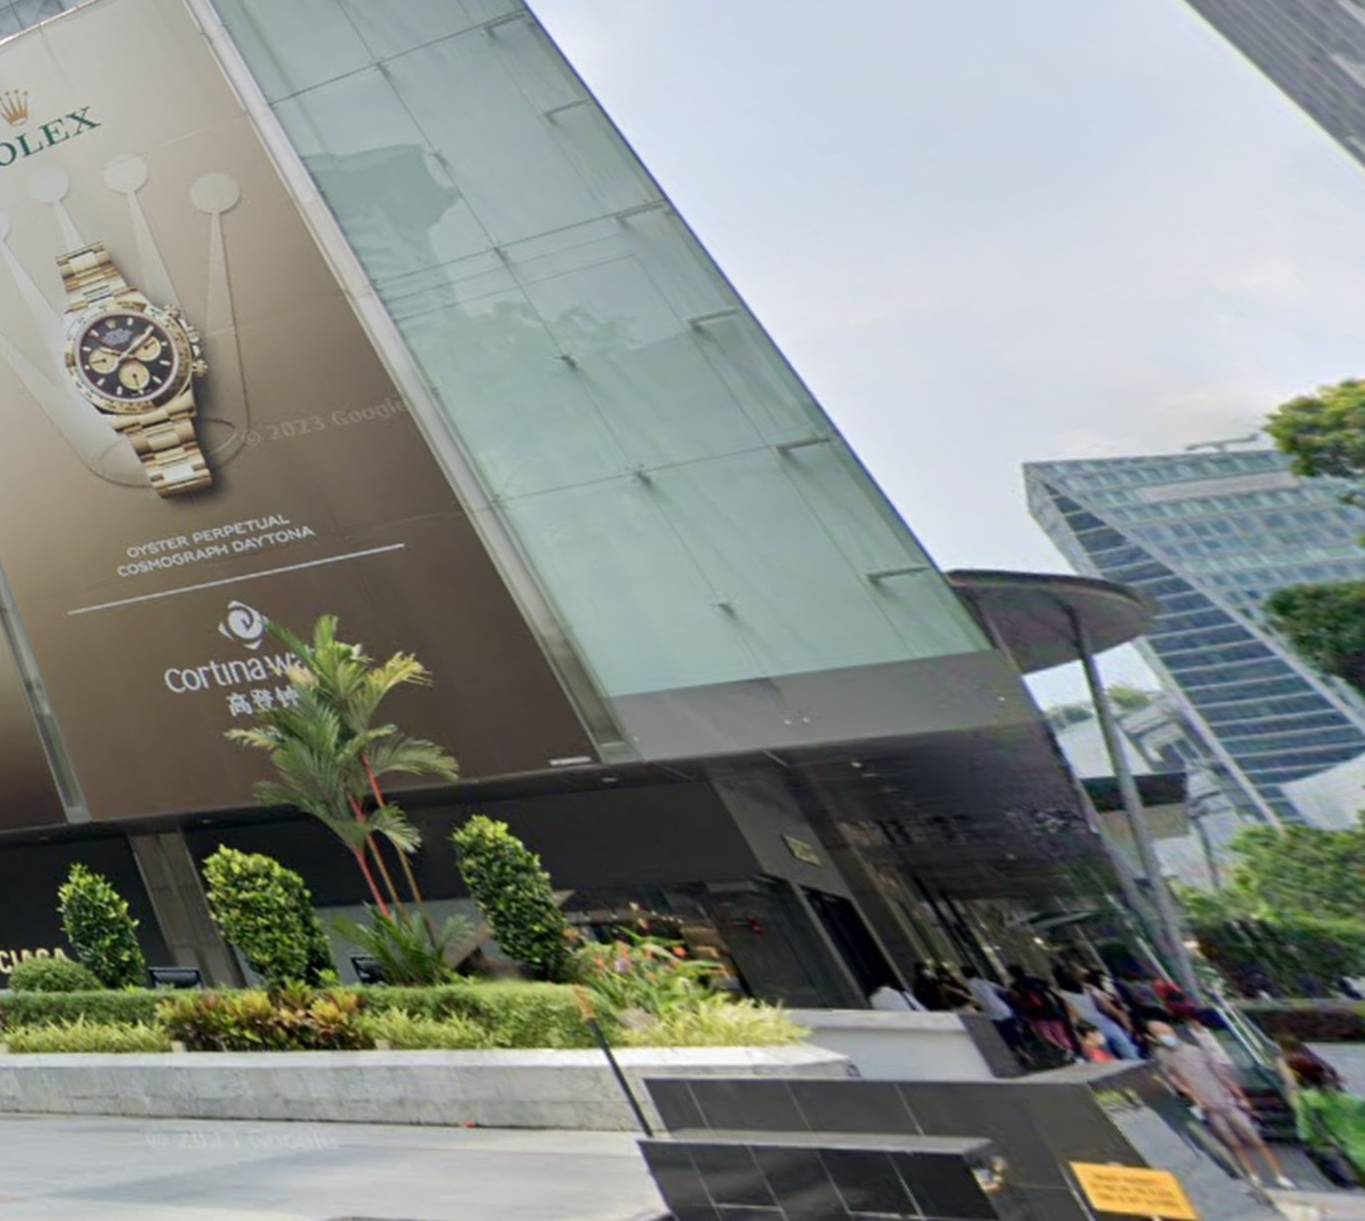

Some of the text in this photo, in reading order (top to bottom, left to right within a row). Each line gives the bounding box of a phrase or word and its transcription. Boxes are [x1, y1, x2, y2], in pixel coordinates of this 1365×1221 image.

[117, 525, 316, 577] COSMOGRAPH DAYTONA
[126, 514, 291, 559] OYSTER PERPETUAL
